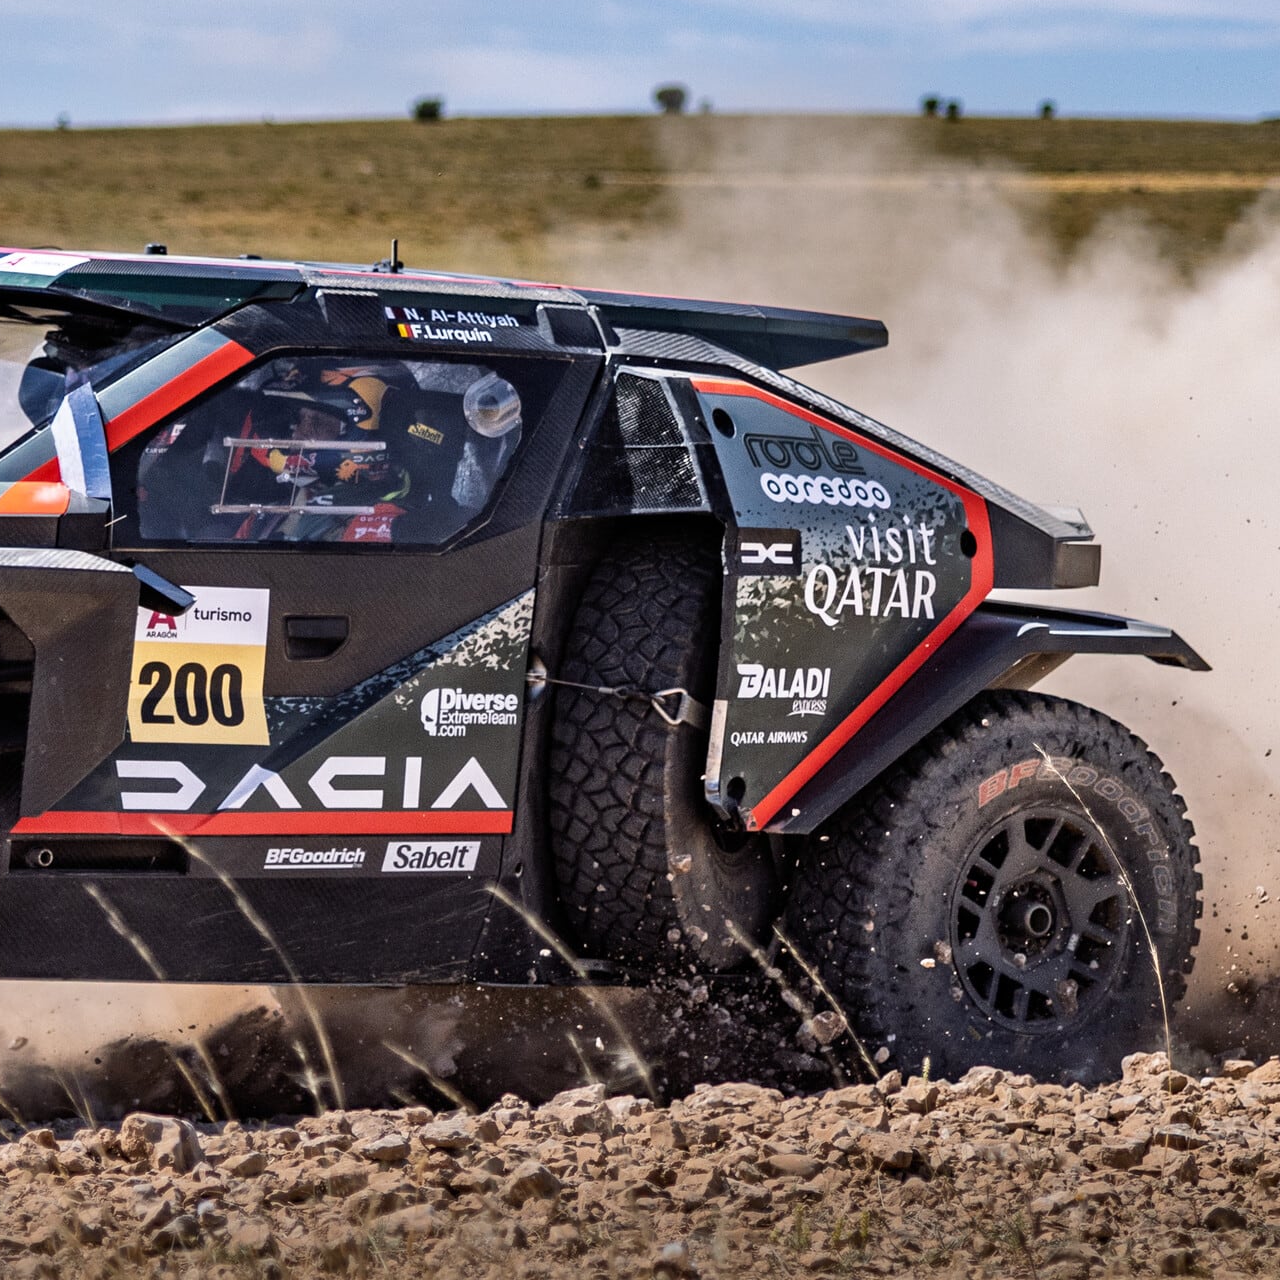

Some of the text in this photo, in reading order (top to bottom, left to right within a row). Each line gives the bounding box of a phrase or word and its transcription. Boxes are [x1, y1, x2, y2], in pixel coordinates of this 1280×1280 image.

[403, 307, 520, 329] N. Al-Attiyah
[410, 323, 493, 344] F.Lurquin
[764, 477, 888, 505] ooredoo
[845, 512, 937, 566] visit
[804, 563, 937, 627] QATAR
[194, 607, 252, 622] turismo
[146, 630, 178, 639] ARAGÓN
[737, 664, 831, 699] BALADI
[138, 661, 245, 728] 200
[441, 687, 518, 711] Diverse
[440, 709, 518, 726] ExtremeTeam
[437, 724, 467, 737] .com
[730, 731, 809, 747] QATAR AIRWAYS
[116, 756, 508, 811] DACIA
[265, 844, 470, 869] BFGoodrich Sabelt
